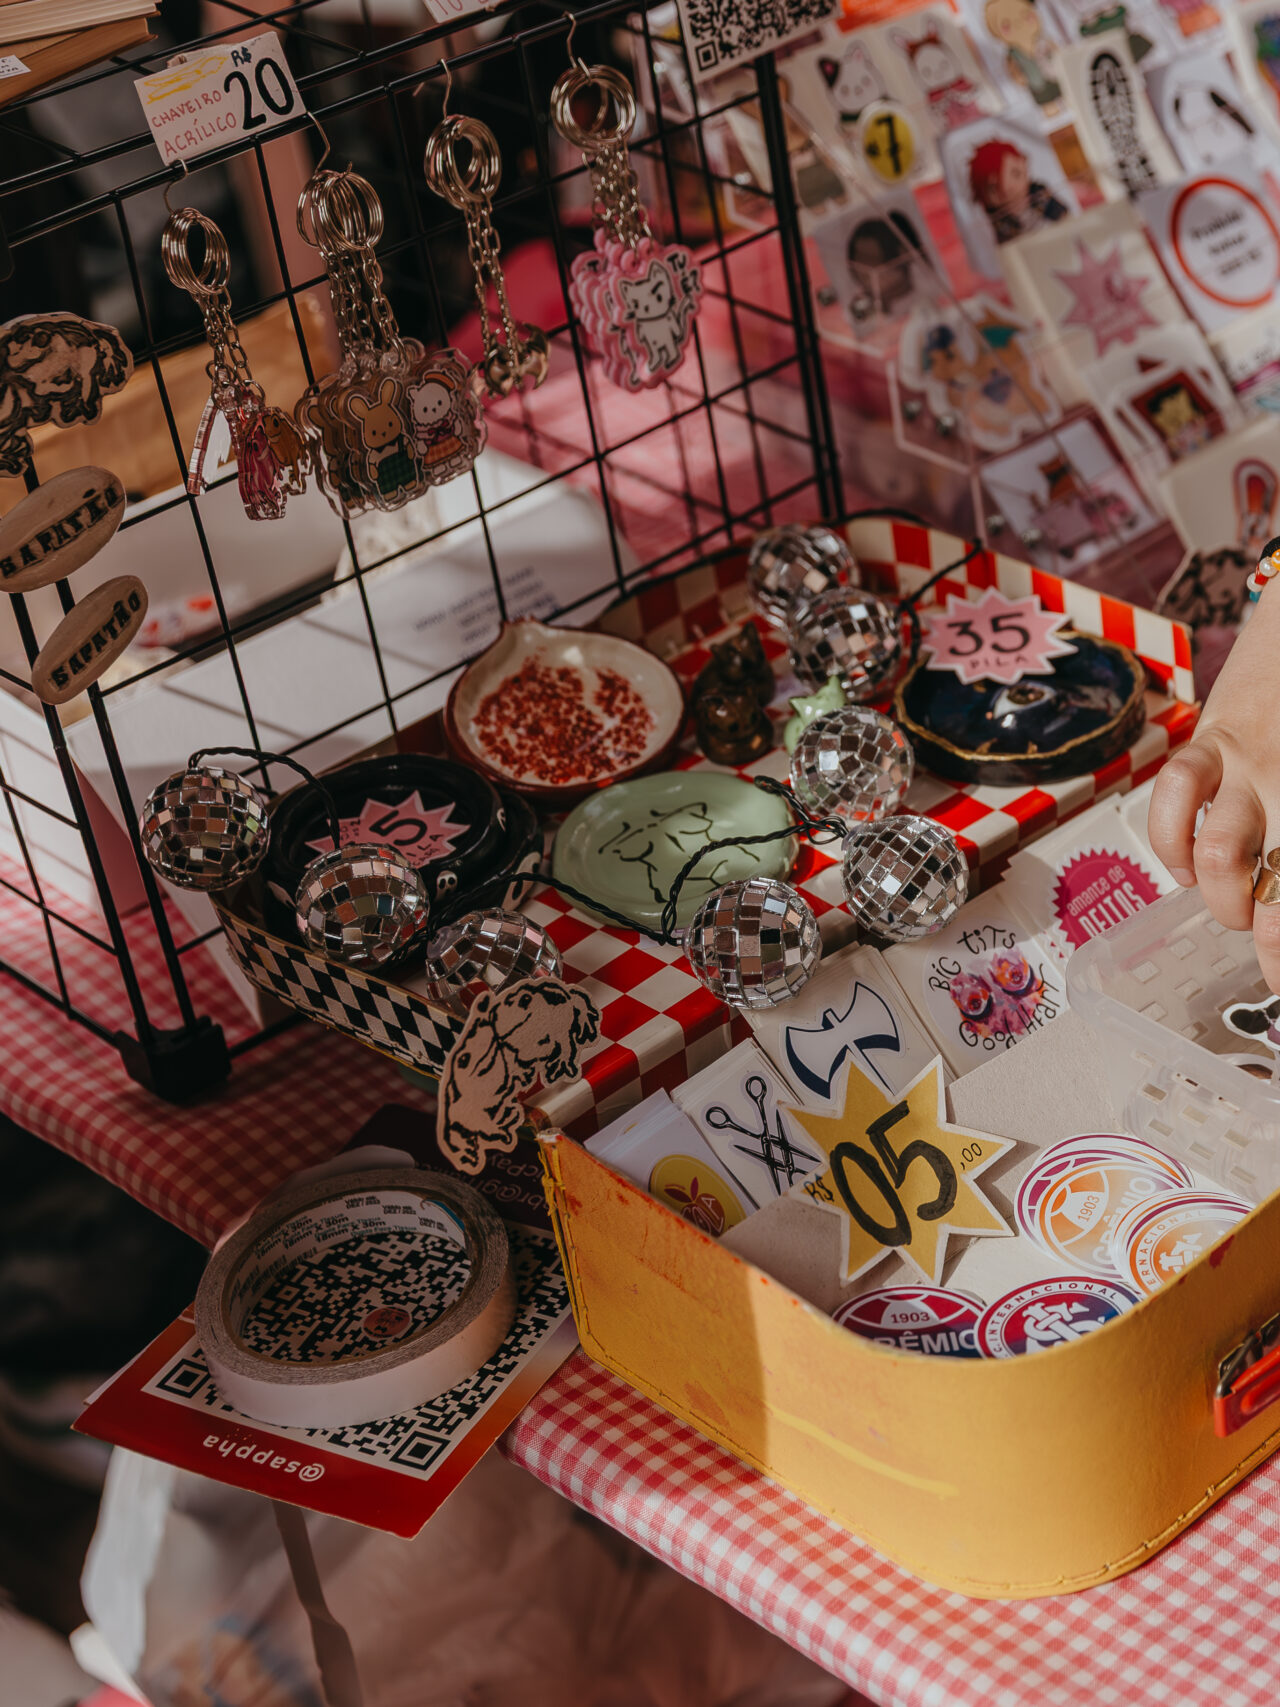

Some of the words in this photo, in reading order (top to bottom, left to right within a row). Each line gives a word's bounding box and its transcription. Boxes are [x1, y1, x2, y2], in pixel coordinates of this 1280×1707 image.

[152, 90, 222, 128] CHAVEIRO
[224, 58, 294, 130] 20
[164, 112, 236, 157] ACRÍLICO
[50, 590, 140, 691] SAPATÃO
[947, 612, 1030, 655] 35
[970, 654, 1029, 669] PILA
[406, 834, 444, 858] ILA
[1067, 876, 1111, 916] amante
[1108, 865, 1126, 884] de
[804, 1173, 835, 1205] R$
[830, 1100, 958, 1247] 05
[960, 1143, 983, 1170] ,00
[362, 1220, 386, 1228] 30m
[1078, 1195, 1100, 1222] 1903
[891, 1312, 930, 1324] 1903
[989, 1283, 1118, 1342] INTERNACIONAL
[203, 1435, 325, 1482] @sappha
